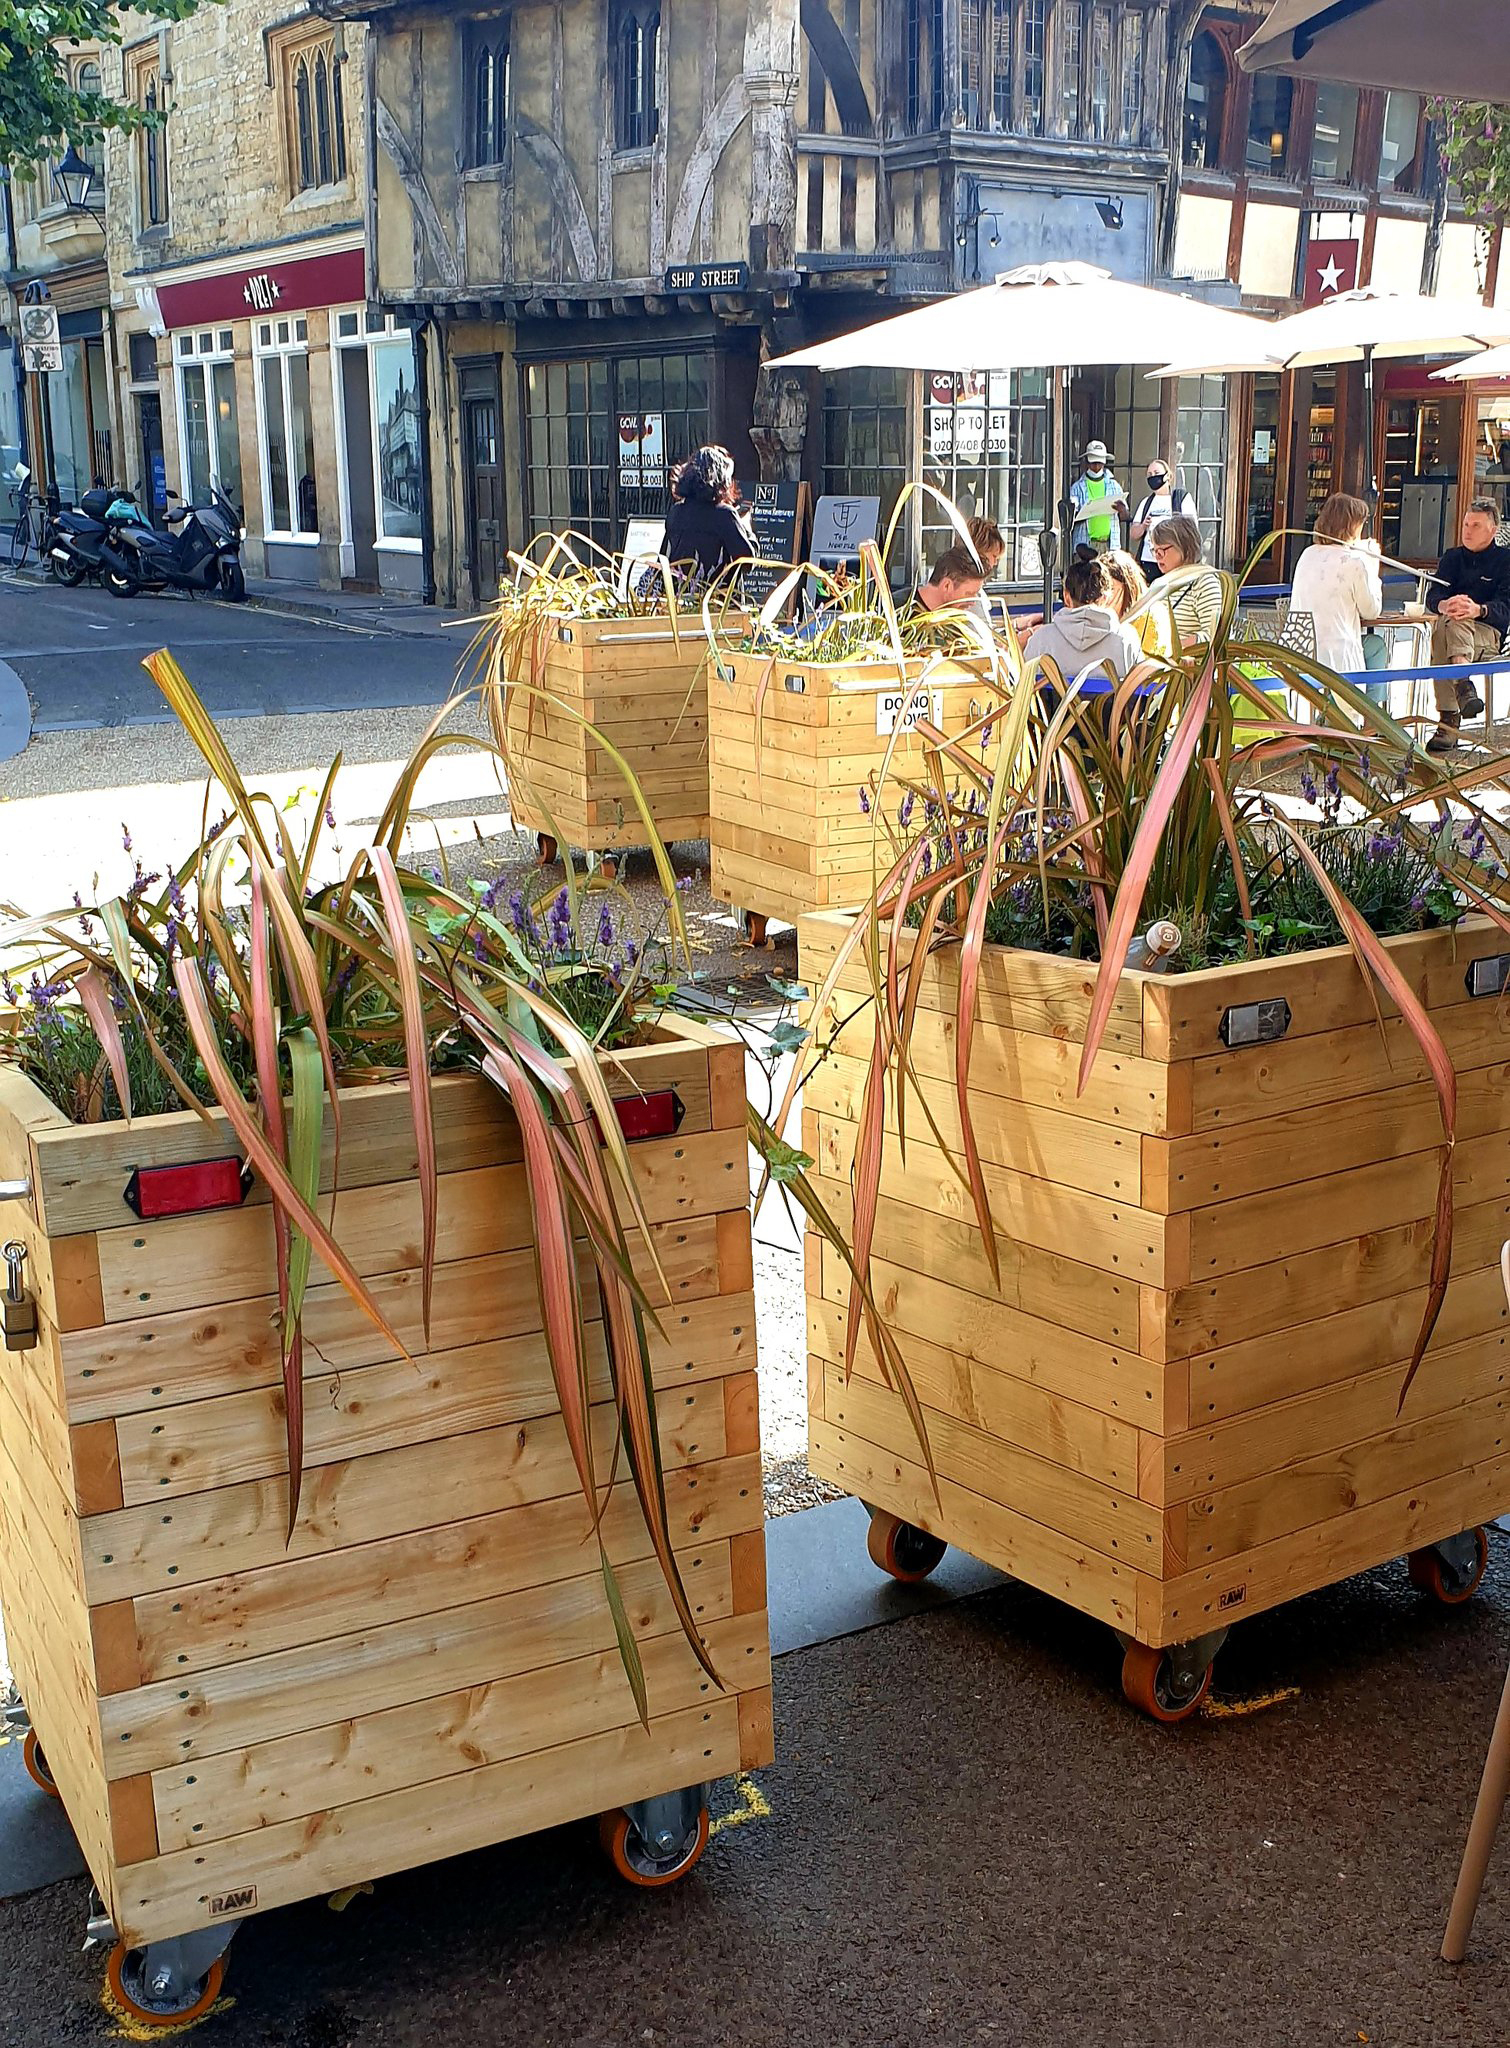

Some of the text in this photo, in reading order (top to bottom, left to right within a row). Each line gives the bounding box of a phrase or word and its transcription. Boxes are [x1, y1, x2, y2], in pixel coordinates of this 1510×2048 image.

[671, 269, 740, 288] SHIP STREET
[248, 274, 273, 310] PRET
[969, 416, 983, 430] TO
[884, 697, 905, 711] DO
[1220, 1587, 1245, 1608] RAW
[211, 1889, 254, 1914] RAW
